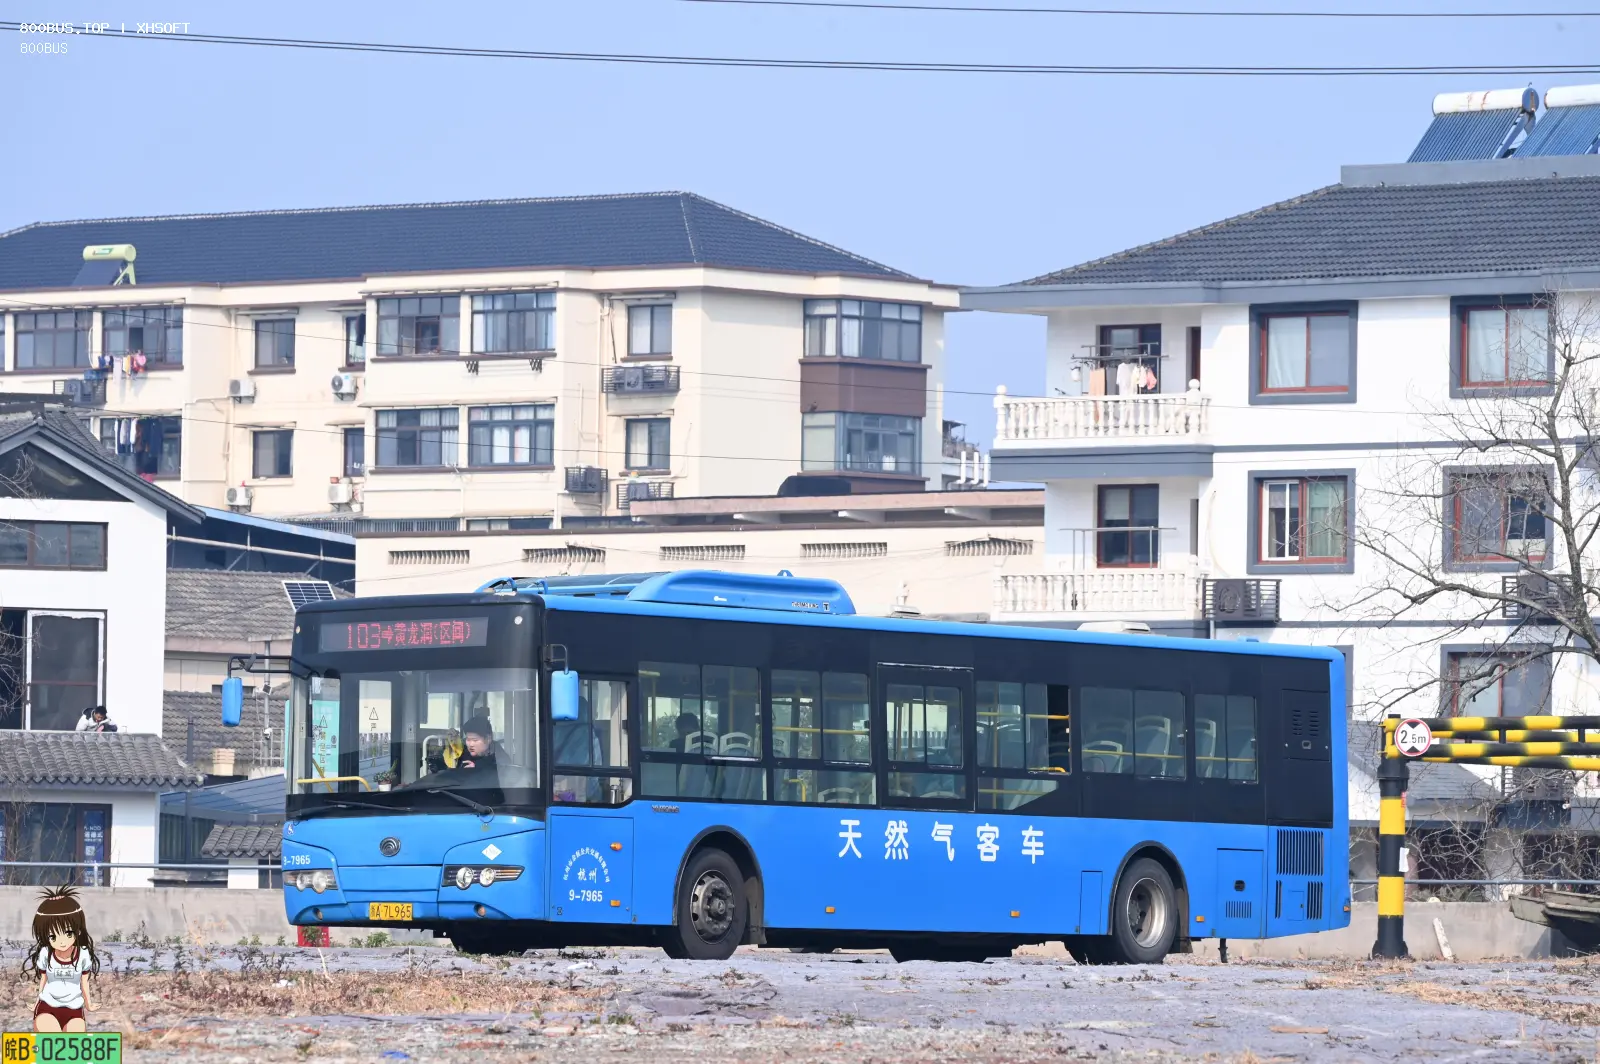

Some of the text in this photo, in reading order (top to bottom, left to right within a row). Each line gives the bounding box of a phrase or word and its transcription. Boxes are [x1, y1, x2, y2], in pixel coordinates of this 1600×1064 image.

[347, 623, 381, 649] 103
[1400, 730, 1427, 744] 2.5m
[838, 819, 1045, 865] 天然气客车
[577, 867, 597, 884] 杭州
[568, 888, 603, 902] 9-7965
